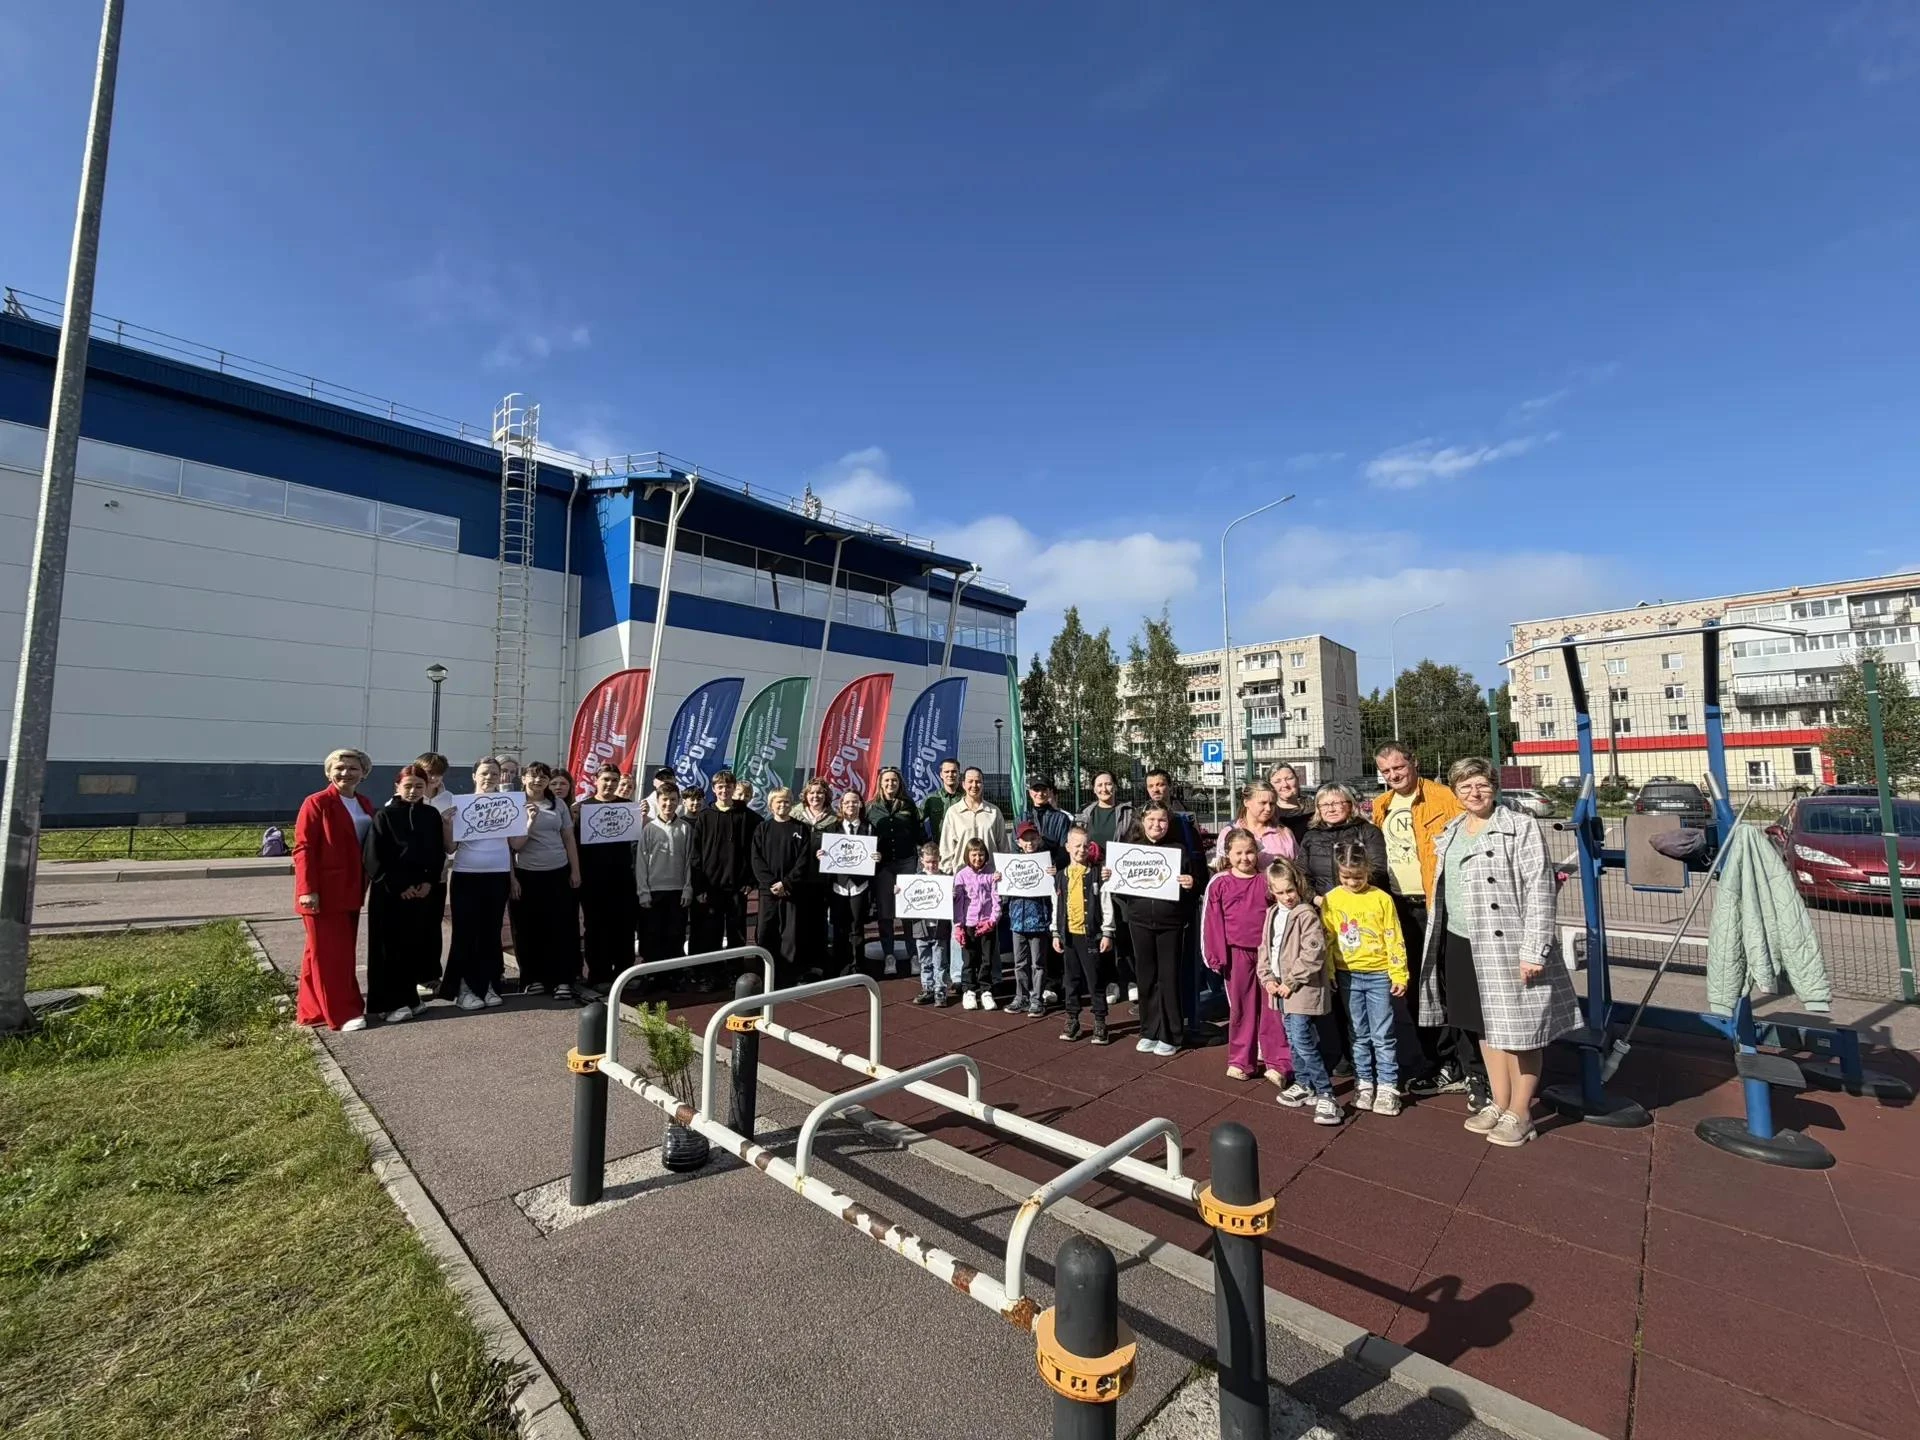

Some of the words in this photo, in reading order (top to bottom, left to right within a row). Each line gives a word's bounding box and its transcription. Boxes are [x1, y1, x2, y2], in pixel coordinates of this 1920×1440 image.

[1208, 743, 1219, 760] P
[475, 800, 508, 811] ВЛЕТАЕМ
[477, 815, 508, 828] СЕЗОН!
[837, 854, 862, 863] СПОРТ!
[1015, 863, 1027, 871] МЫ
[1127, 867, 1159, 879] ДЕРЕВО
